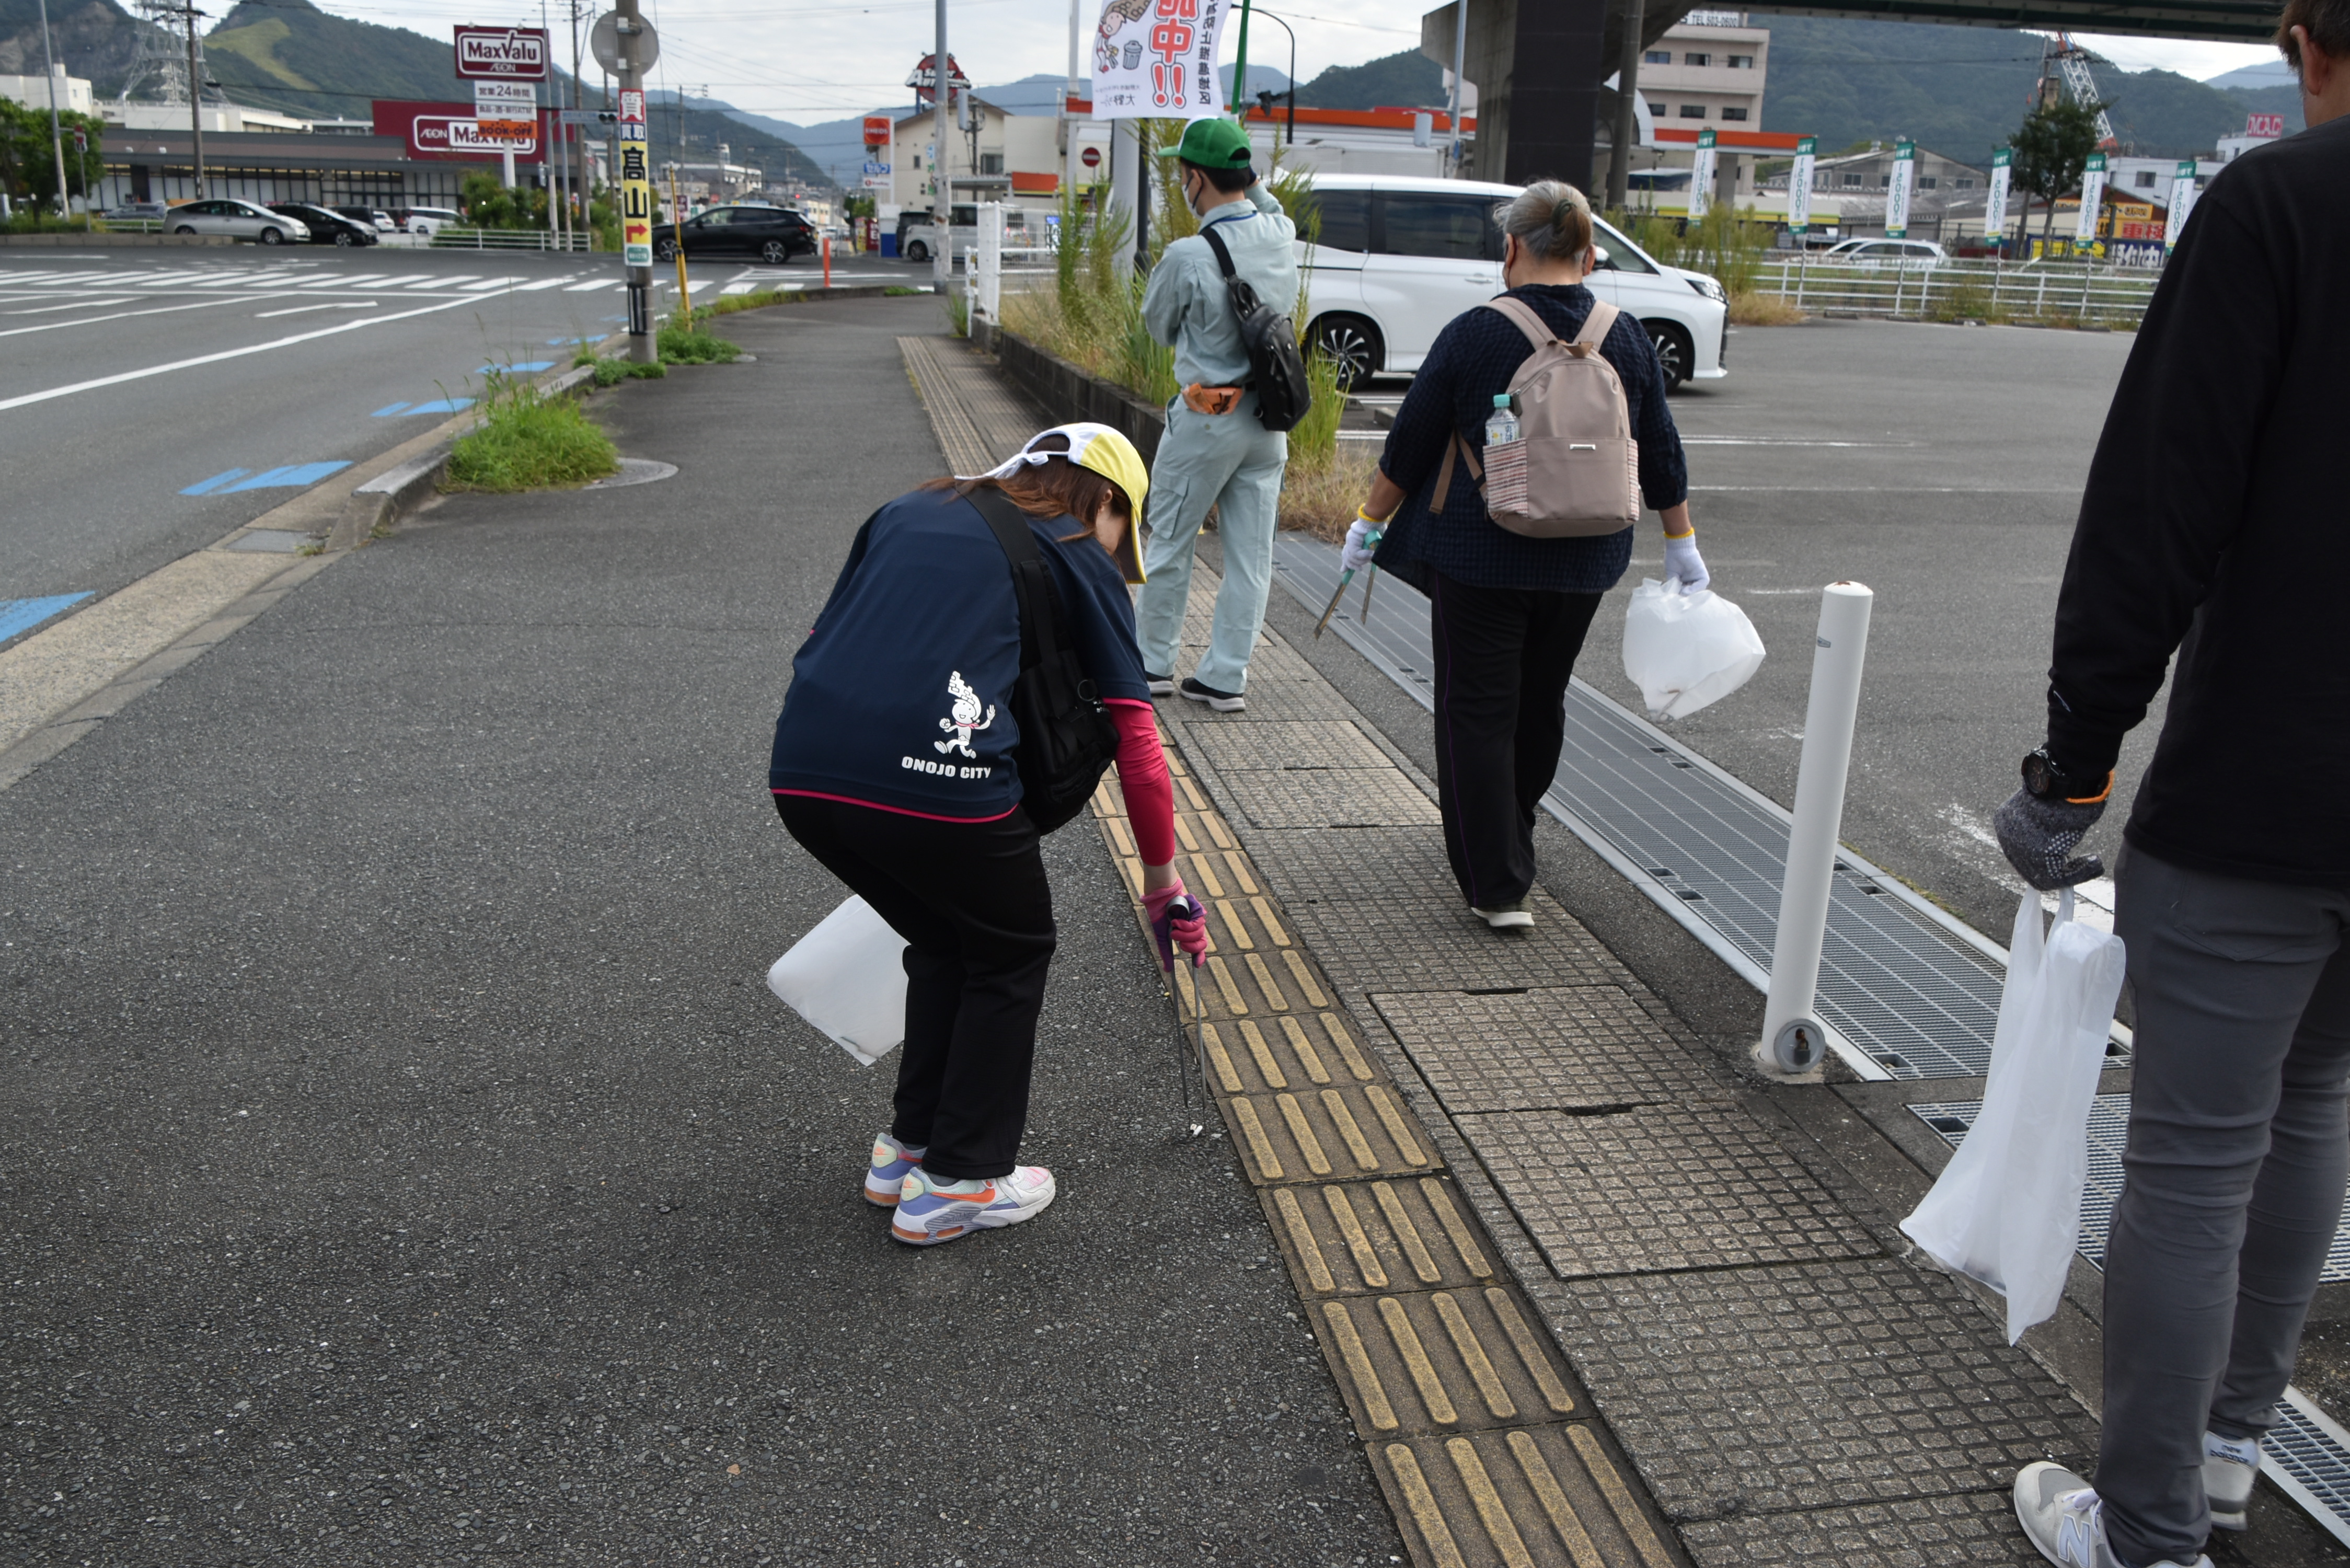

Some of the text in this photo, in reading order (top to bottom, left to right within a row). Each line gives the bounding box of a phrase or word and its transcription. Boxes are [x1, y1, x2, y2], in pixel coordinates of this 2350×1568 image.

[468, 32, 537, 60] MaxValu
[621, 91, 643, 121] 質
[621, 124, 645, 140] 買取
[2249, 116, 2282, 135] MAC
[867, 164, 889, 174] セルフ
[902, 756, 991, 779] ONOJO CITY
[2057, 1514, 2091, 1568] N
